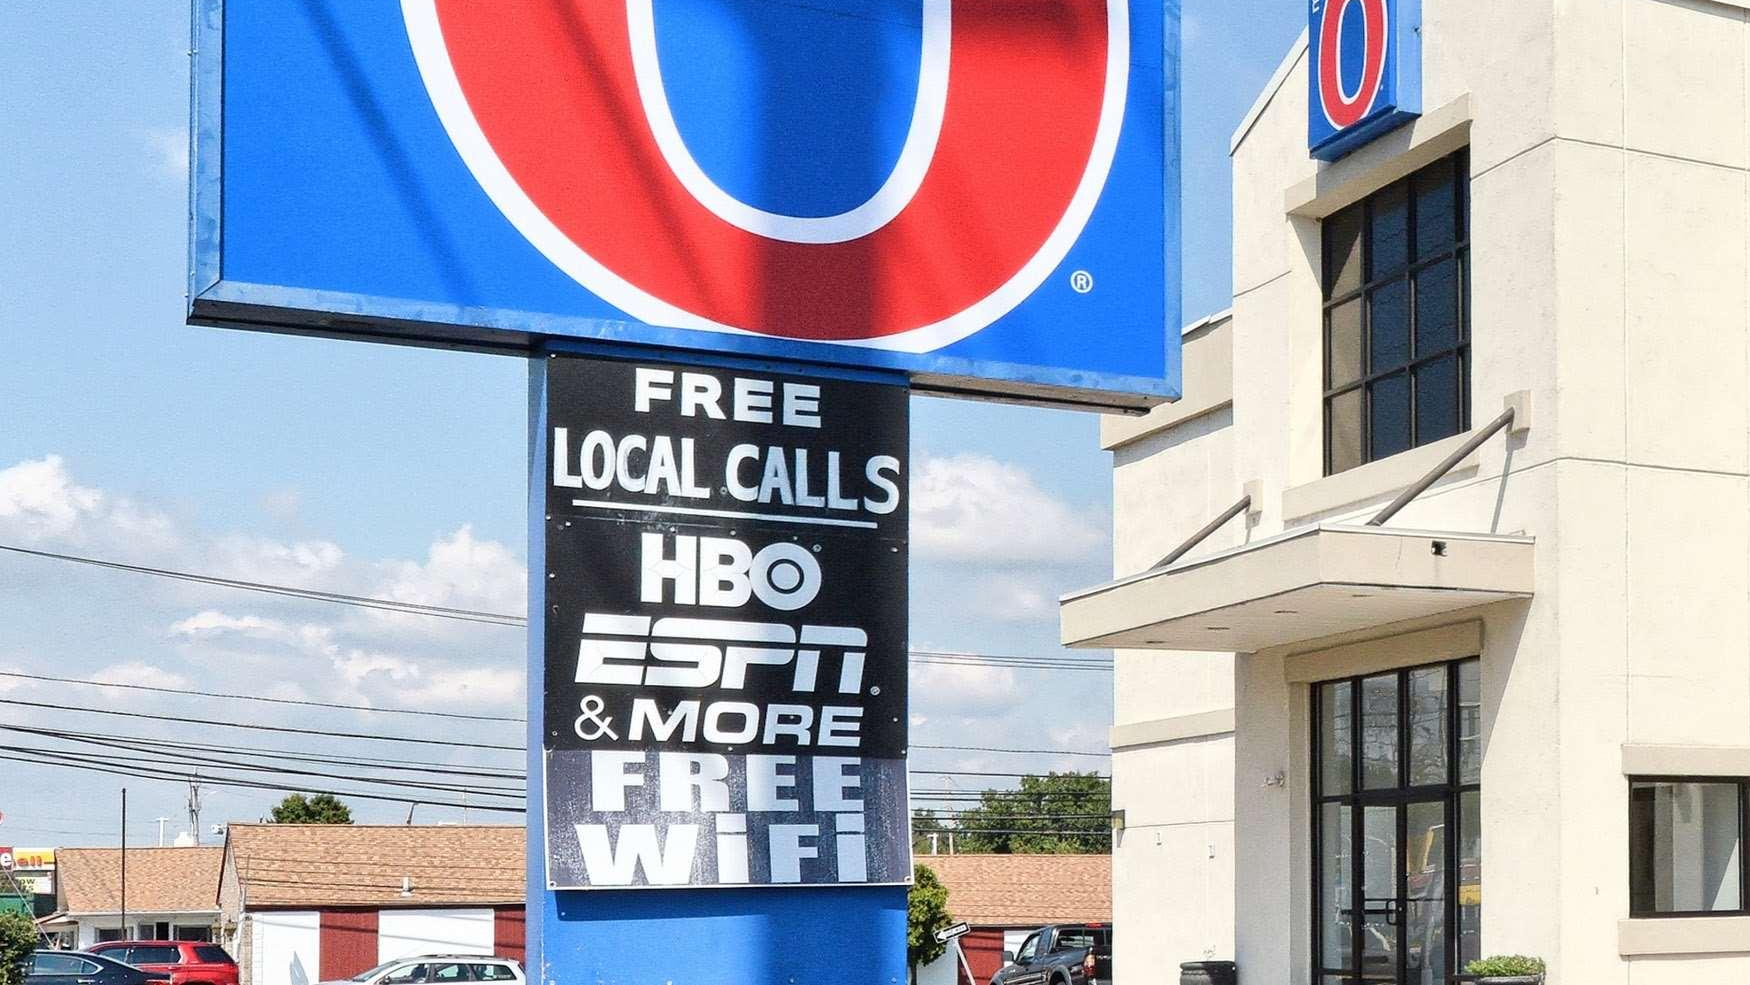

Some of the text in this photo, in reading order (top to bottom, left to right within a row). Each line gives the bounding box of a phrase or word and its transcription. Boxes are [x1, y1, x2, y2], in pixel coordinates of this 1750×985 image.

[634, 367, 821, 428] FREE
[553, 427, 900, 514] LOCAL CALLS
[640, 532, 822, 611] HBO
[574, 613, 868, 694] ESPN
[574, 694, 864, 747] & MORE
[591, 749, 865, 813] FREE
[574, 813, 868, 886] WiFi
